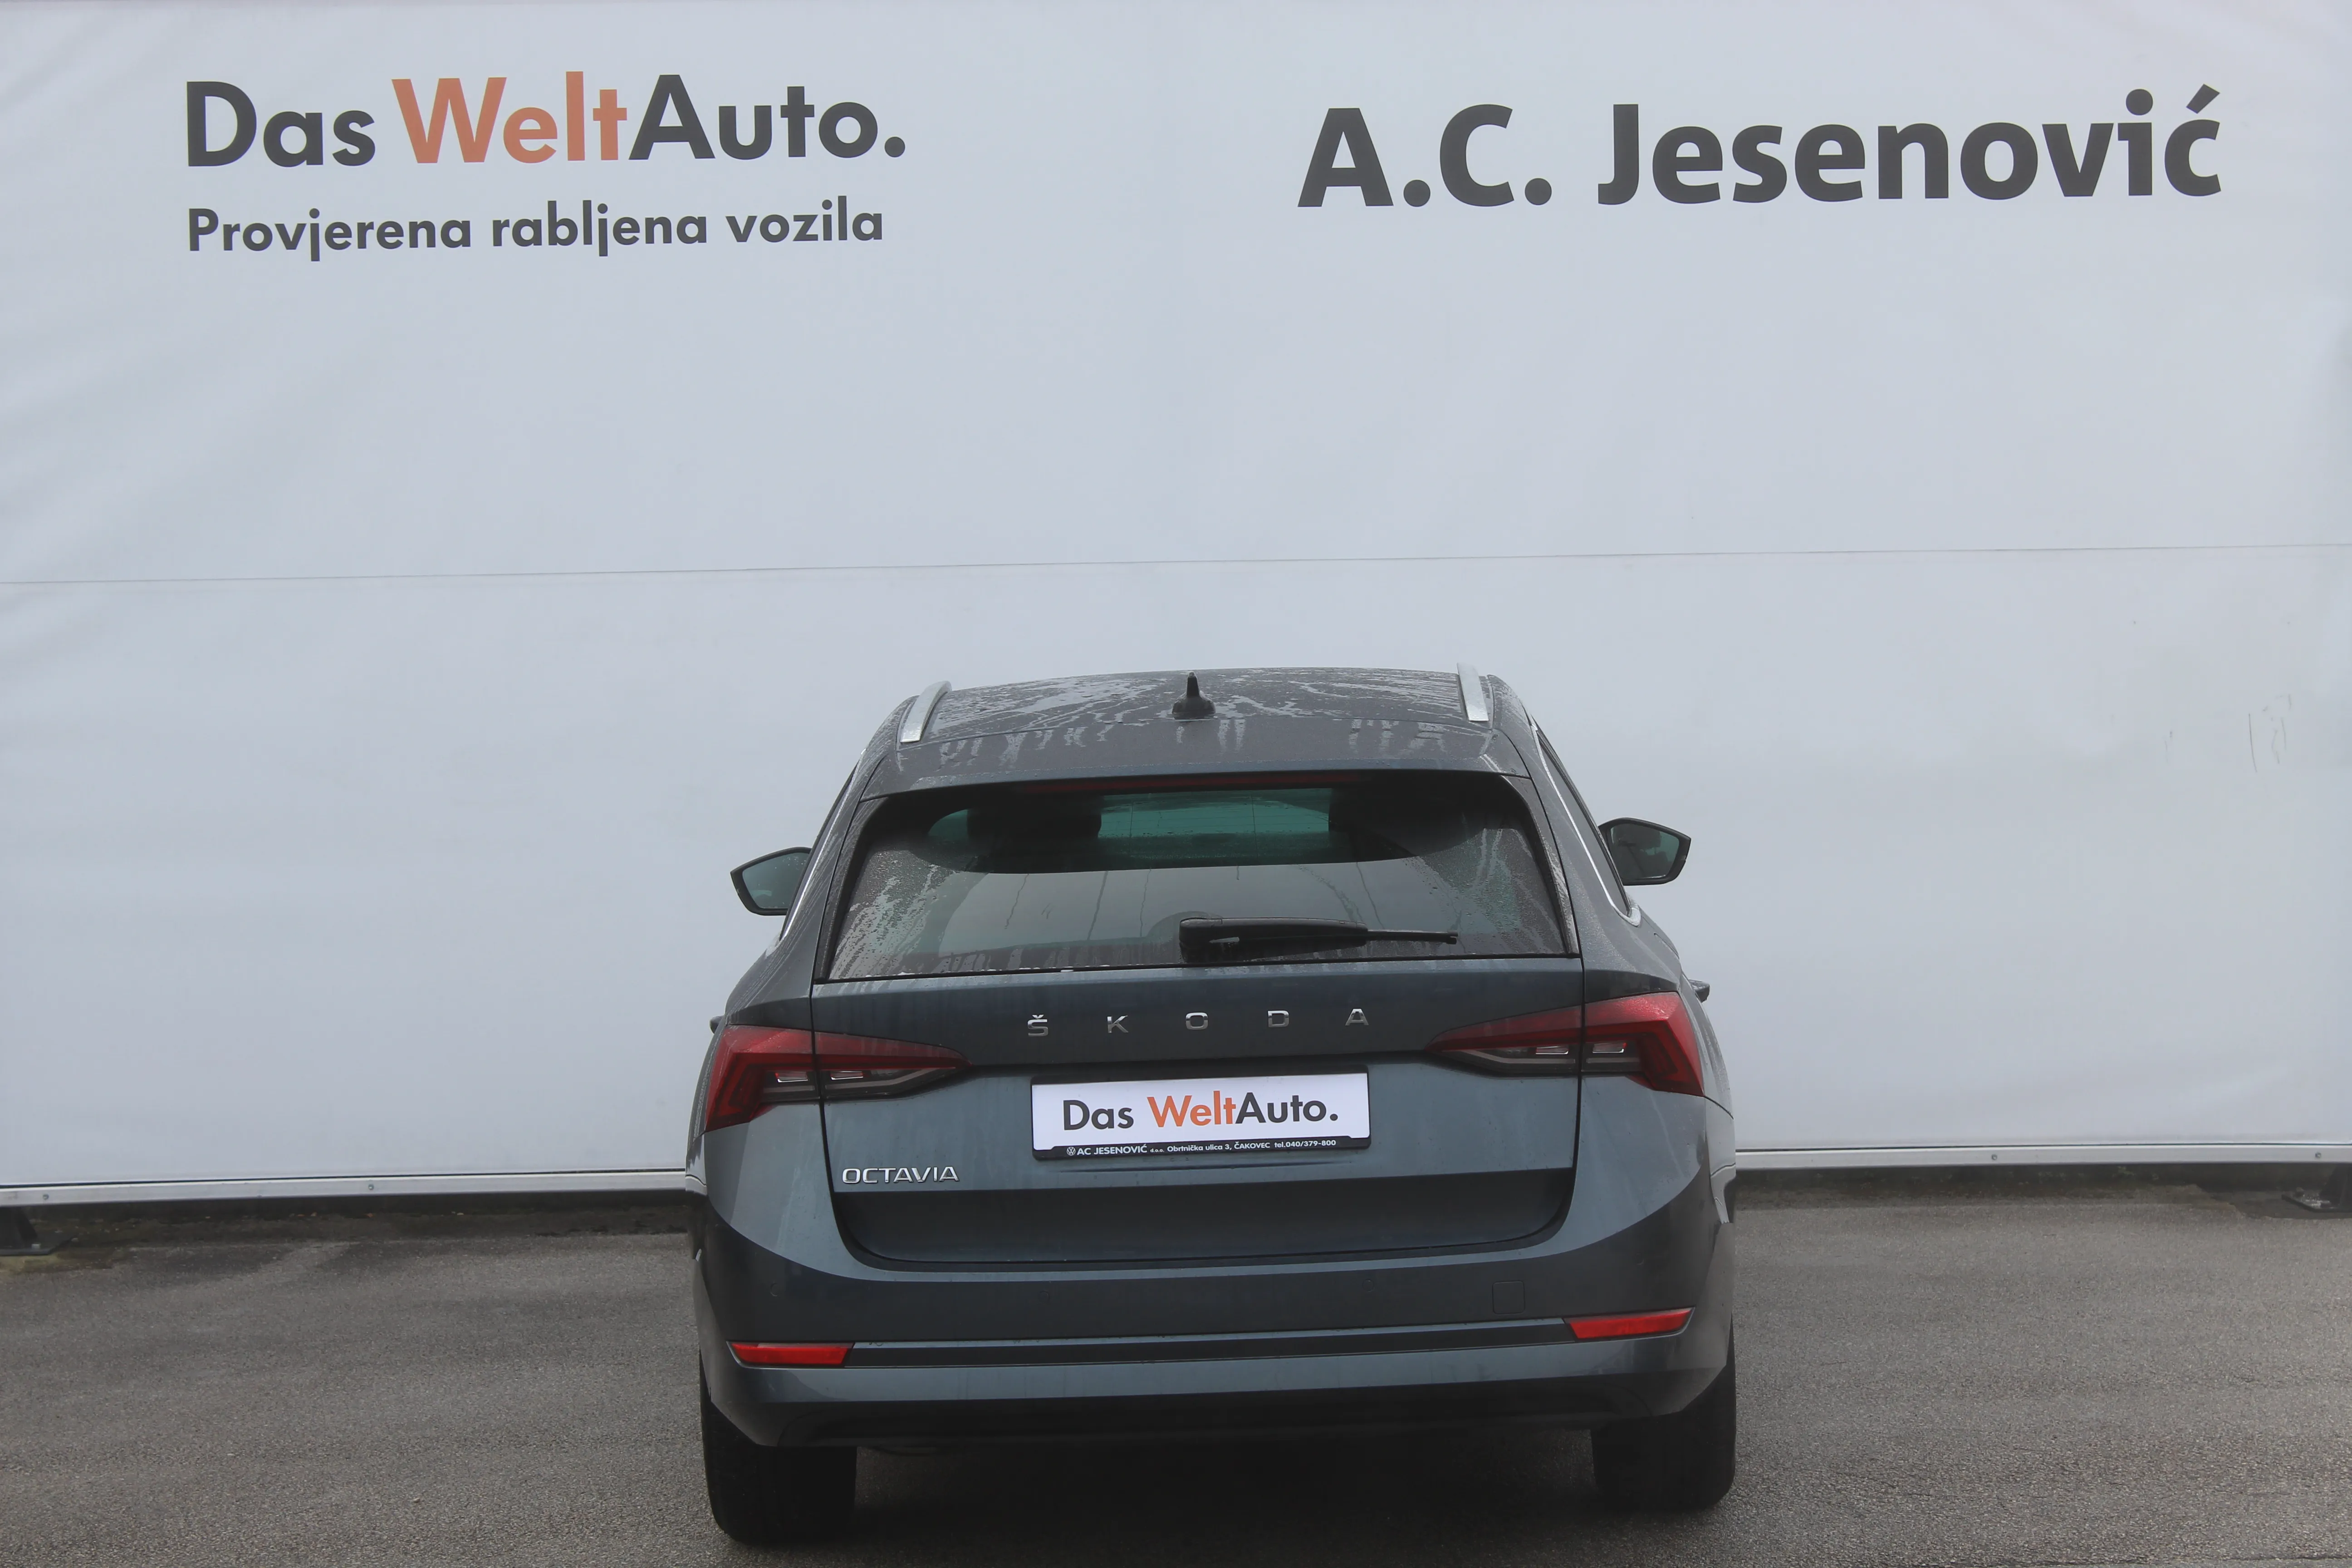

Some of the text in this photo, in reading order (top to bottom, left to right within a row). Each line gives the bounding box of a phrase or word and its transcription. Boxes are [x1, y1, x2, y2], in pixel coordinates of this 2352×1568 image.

[187, 72, 905, 167] Das WeltAuto.
[1298, 84, 2221, 207] A.C. Jesenović
[189, 196, 882, 261] Provjerena rabljena vozila
[1027, 1008, 1369, 1037] ŠKODA
[1063, 1091, 1338, 1130] Das WeltAuto.
[1094, 1144, 1147, 1155] JESENOVIĆ
[1234, 1141, 1270, 1149] ČAKOVEC
[1274, 1140, 1337, 1148] tel.040/379-800
[843, 1166, 960, 1184] OCTAVIA
